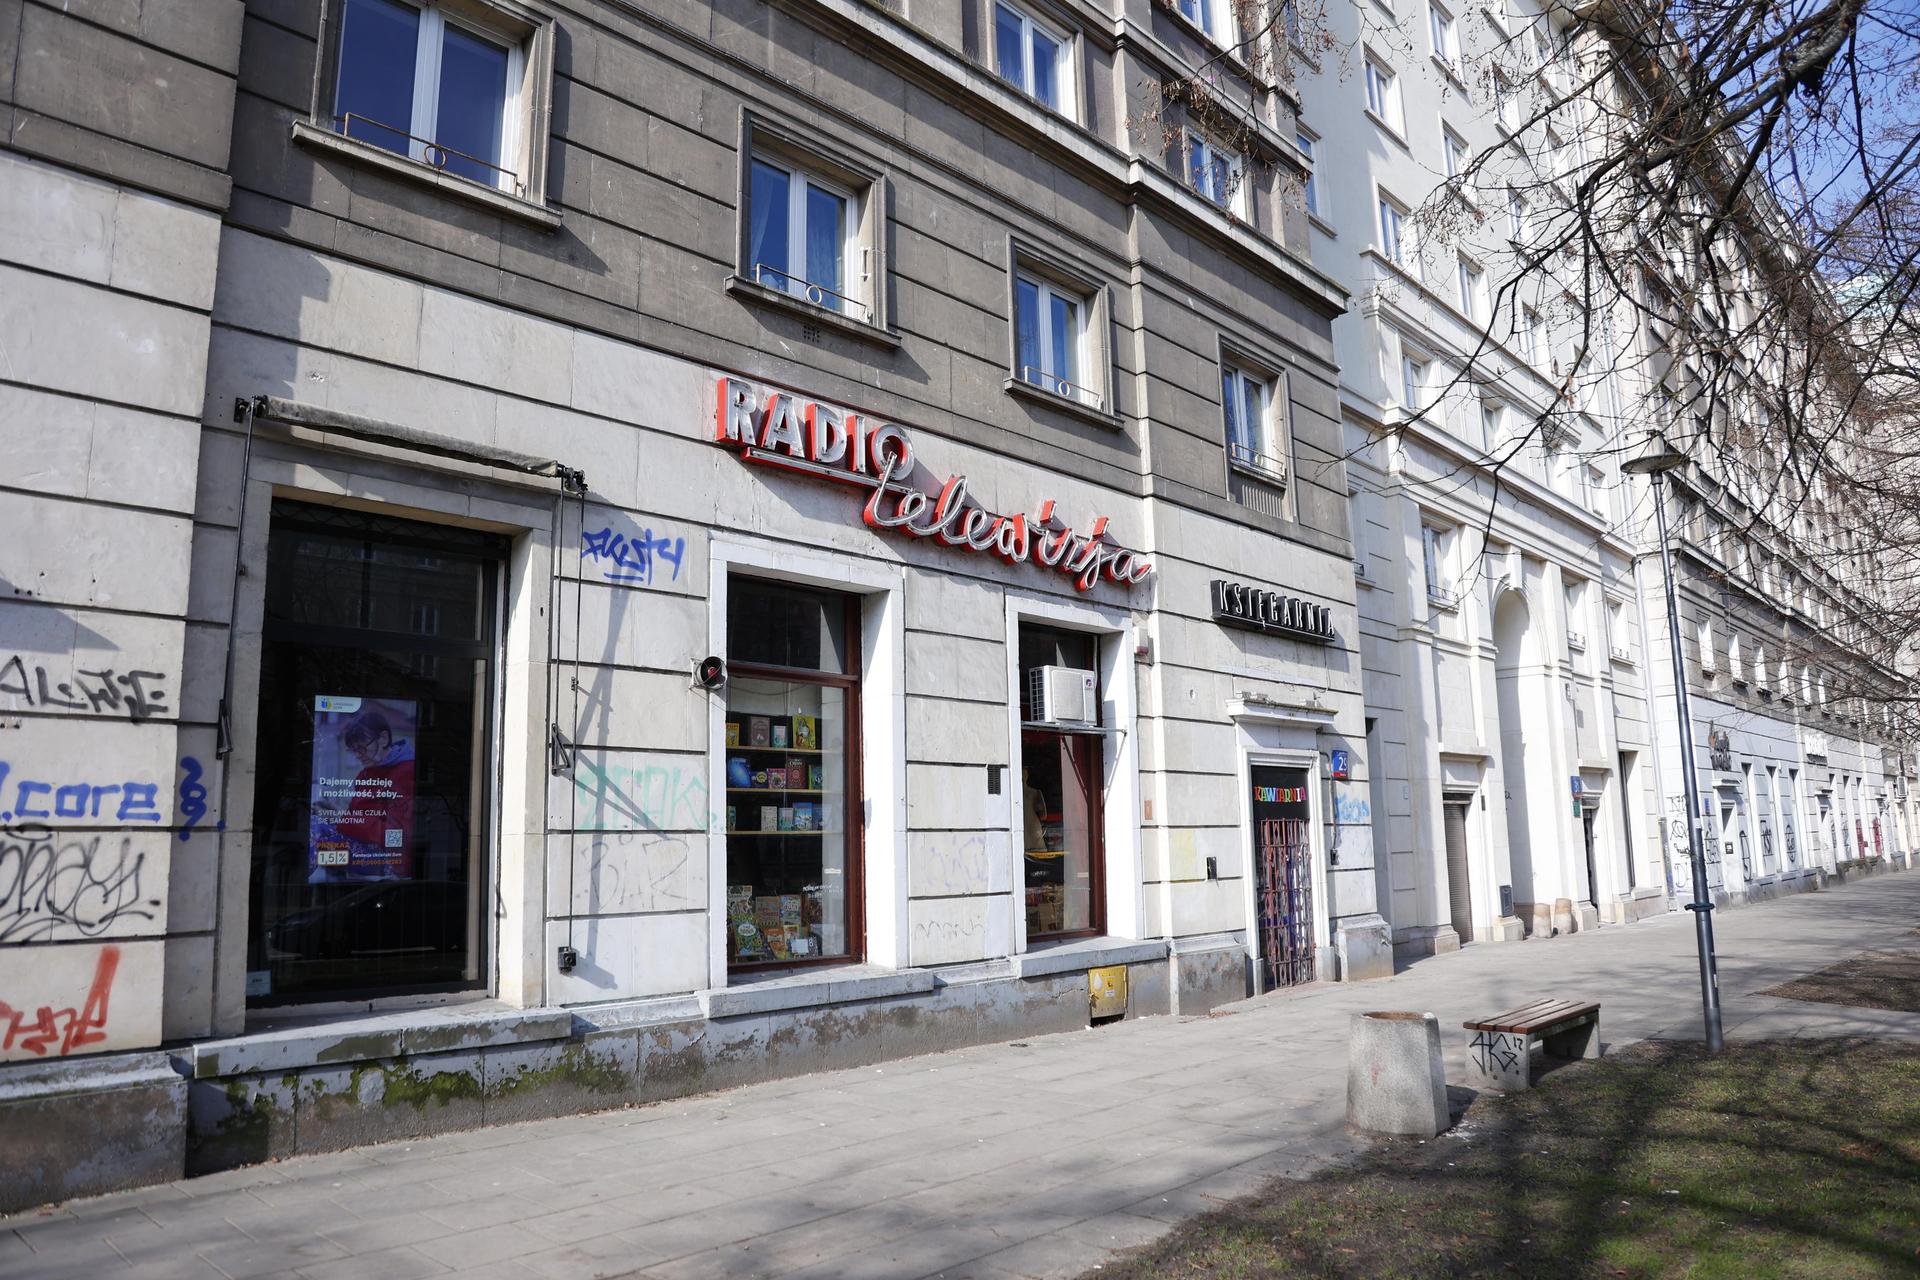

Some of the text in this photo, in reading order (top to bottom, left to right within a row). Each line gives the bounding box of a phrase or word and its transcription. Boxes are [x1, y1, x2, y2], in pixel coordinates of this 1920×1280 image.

[715, 376, 915, 482] RADIO
[1211, 580, 1335, 639] KSIĘGARNIA
[319, 777, 393, 788] Dajemy nadzieję
[323, 788, 375, 799] możliwość,
[1254, 786, 1307, 803] KAWIARNIA
